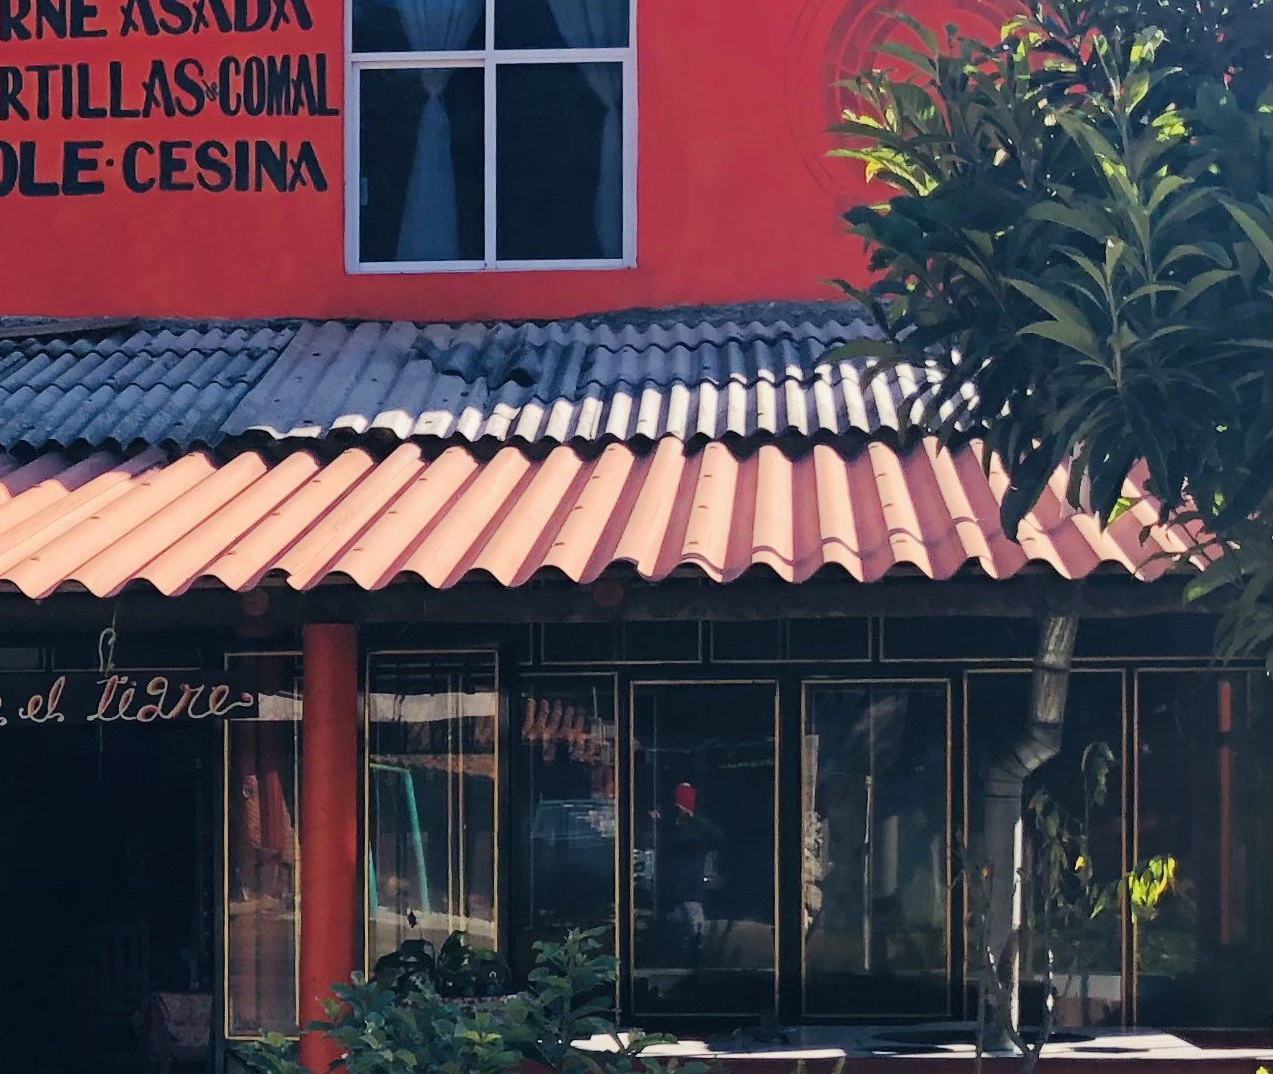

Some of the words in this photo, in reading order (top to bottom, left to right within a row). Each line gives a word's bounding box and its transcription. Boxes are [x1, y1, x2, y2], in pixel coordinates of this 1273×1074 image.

[120, 0, 313, 36] ASADA
[218, 53, 340, 117] COMAL
[122, 140, 329, 193] CESINA
[18, 675, 65, 723] el
